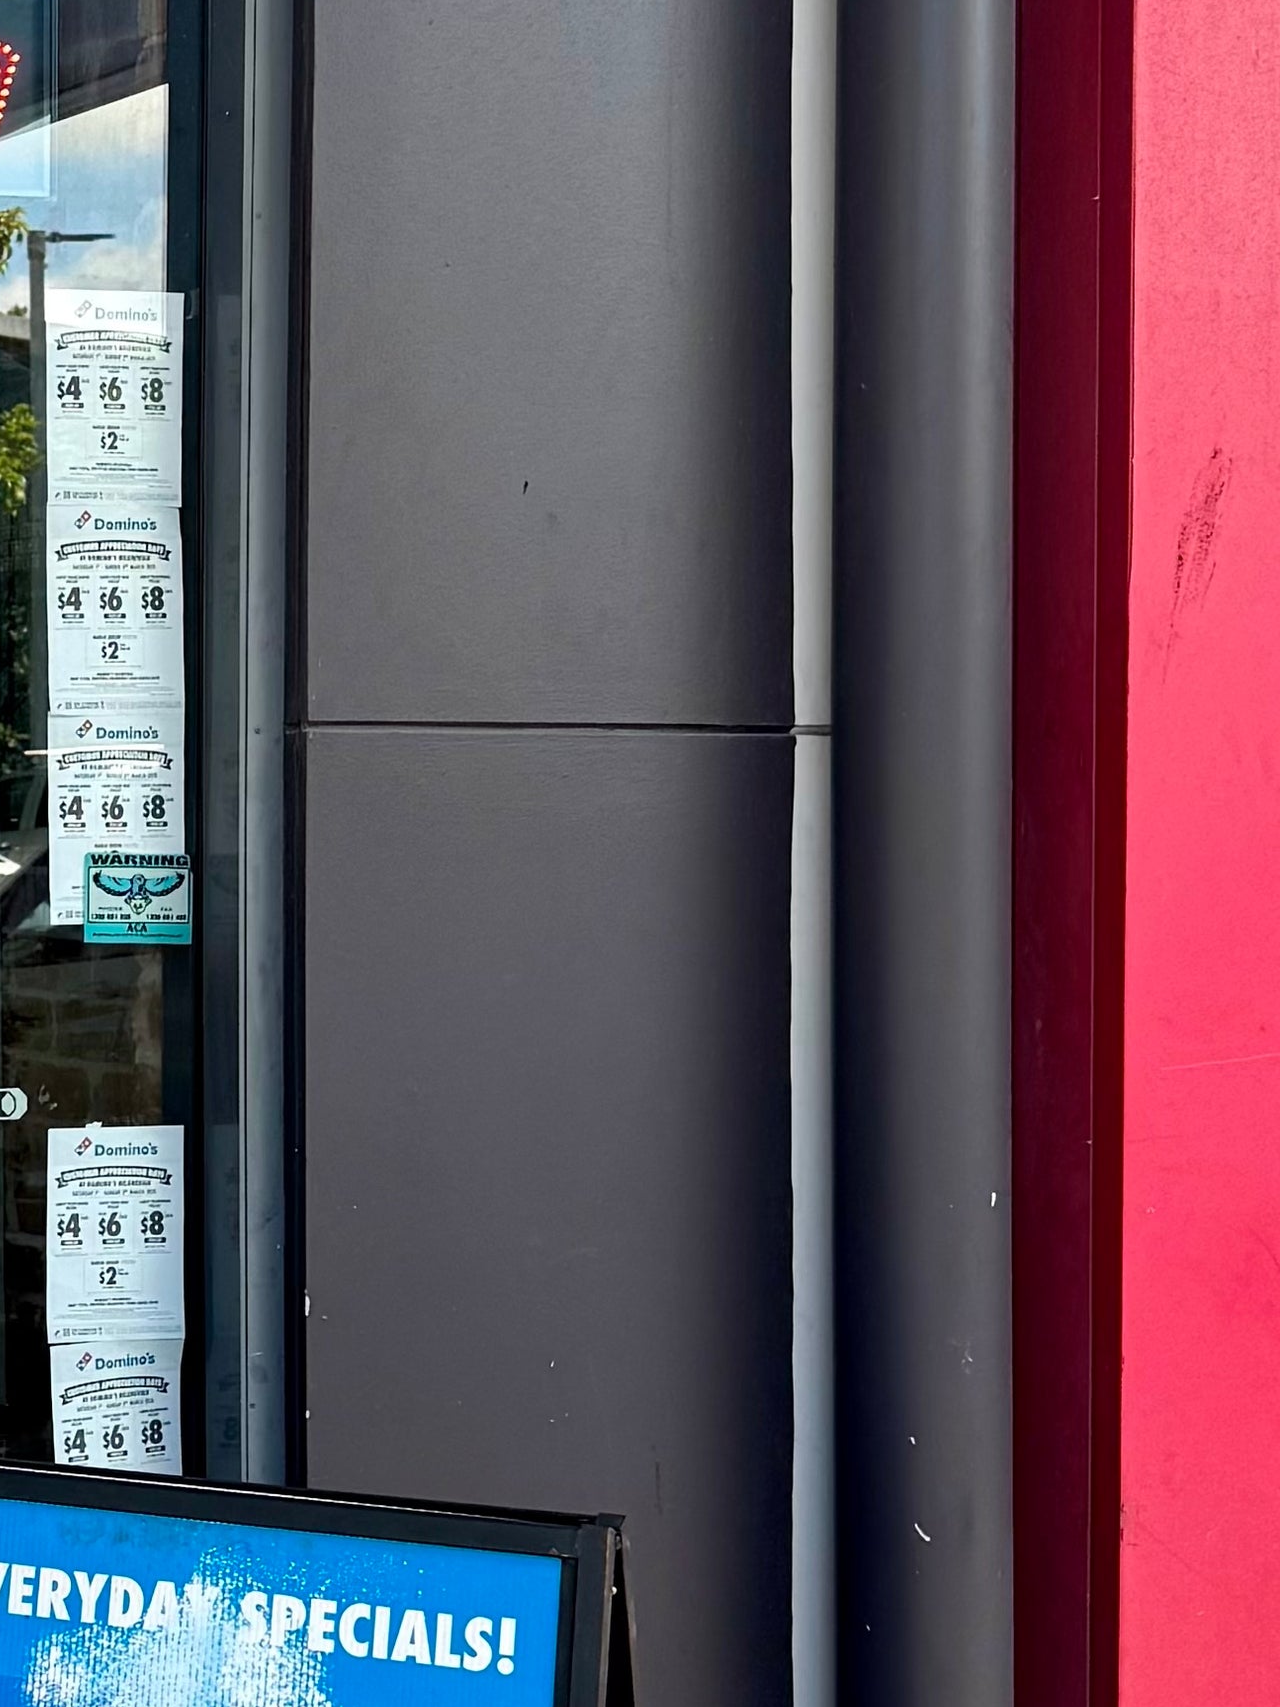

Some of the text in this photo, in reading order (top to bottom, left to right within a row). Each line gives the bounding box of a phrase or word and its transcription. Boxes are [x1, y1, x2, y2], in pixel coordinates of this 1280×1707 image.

[94, 517, 158, 531] Domino's
[57, 586, 165, 612] $4 $6 $8
[90, 853, 189, 866] WARNING
[94, 1142, 158, 1157] Domino's
[57, 1210, 165, 1238] $4 $6 $8
[239, 1589, 517, 1675] SPECIALS!
